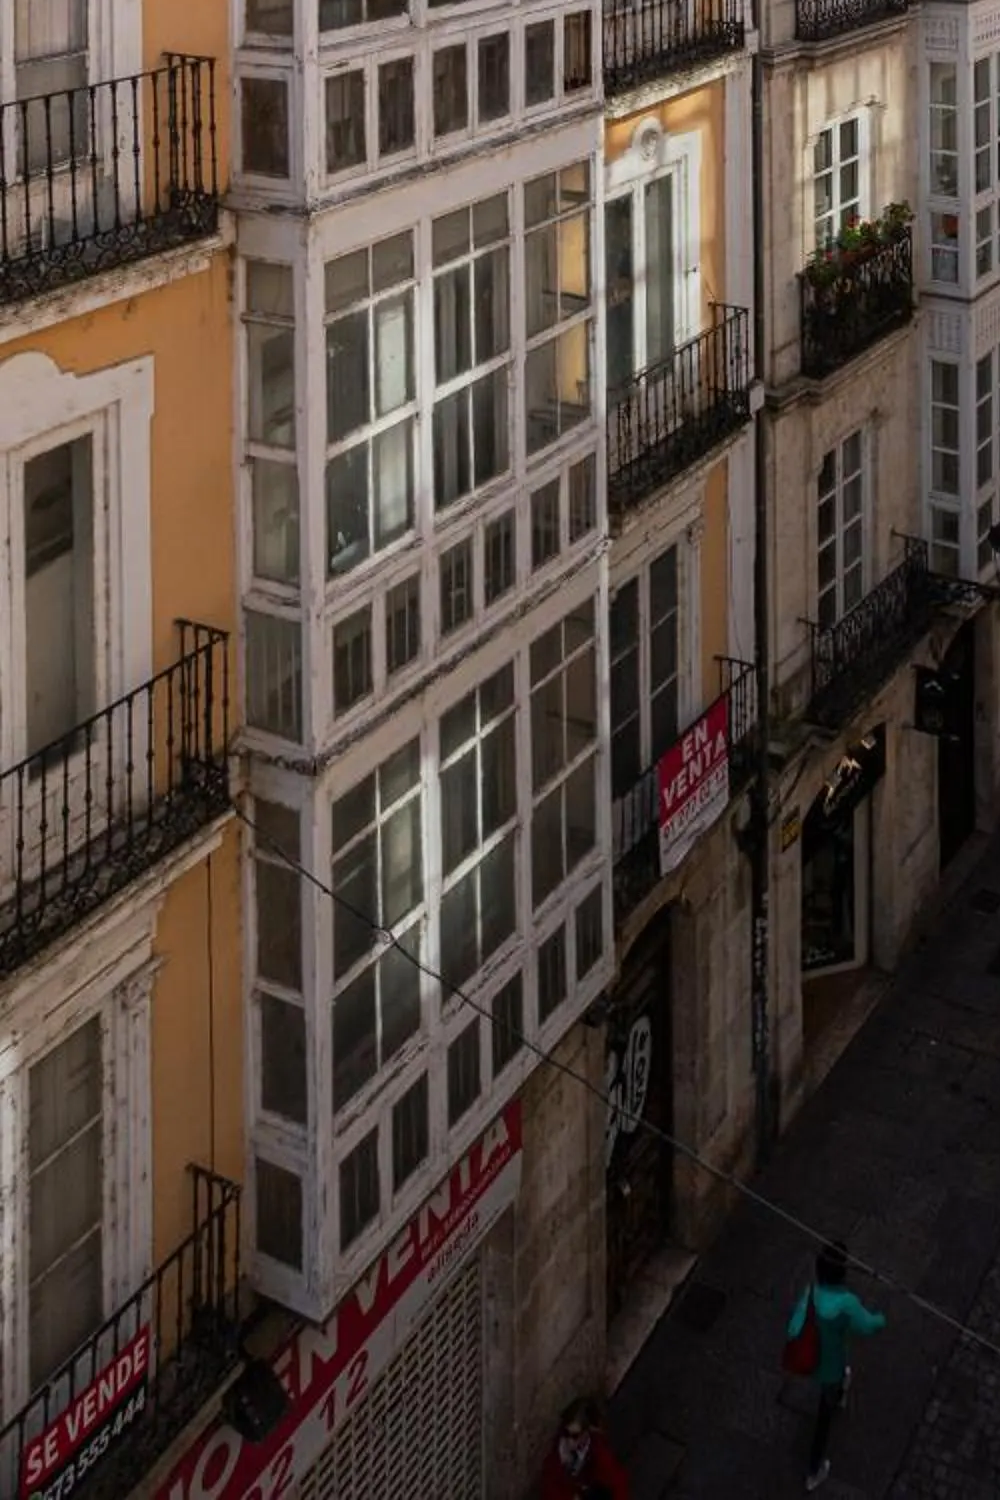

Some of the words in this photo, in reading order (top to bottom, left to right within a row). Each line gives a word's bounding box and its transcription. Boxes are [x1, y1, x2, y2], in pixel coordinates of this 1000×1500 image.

[663, 729, 727, 810] VENTA
[682, 716, 709, 763] EN
[25, 1426, 60, 1486] SE
[64, 1335, 147, 1444] VENDE
